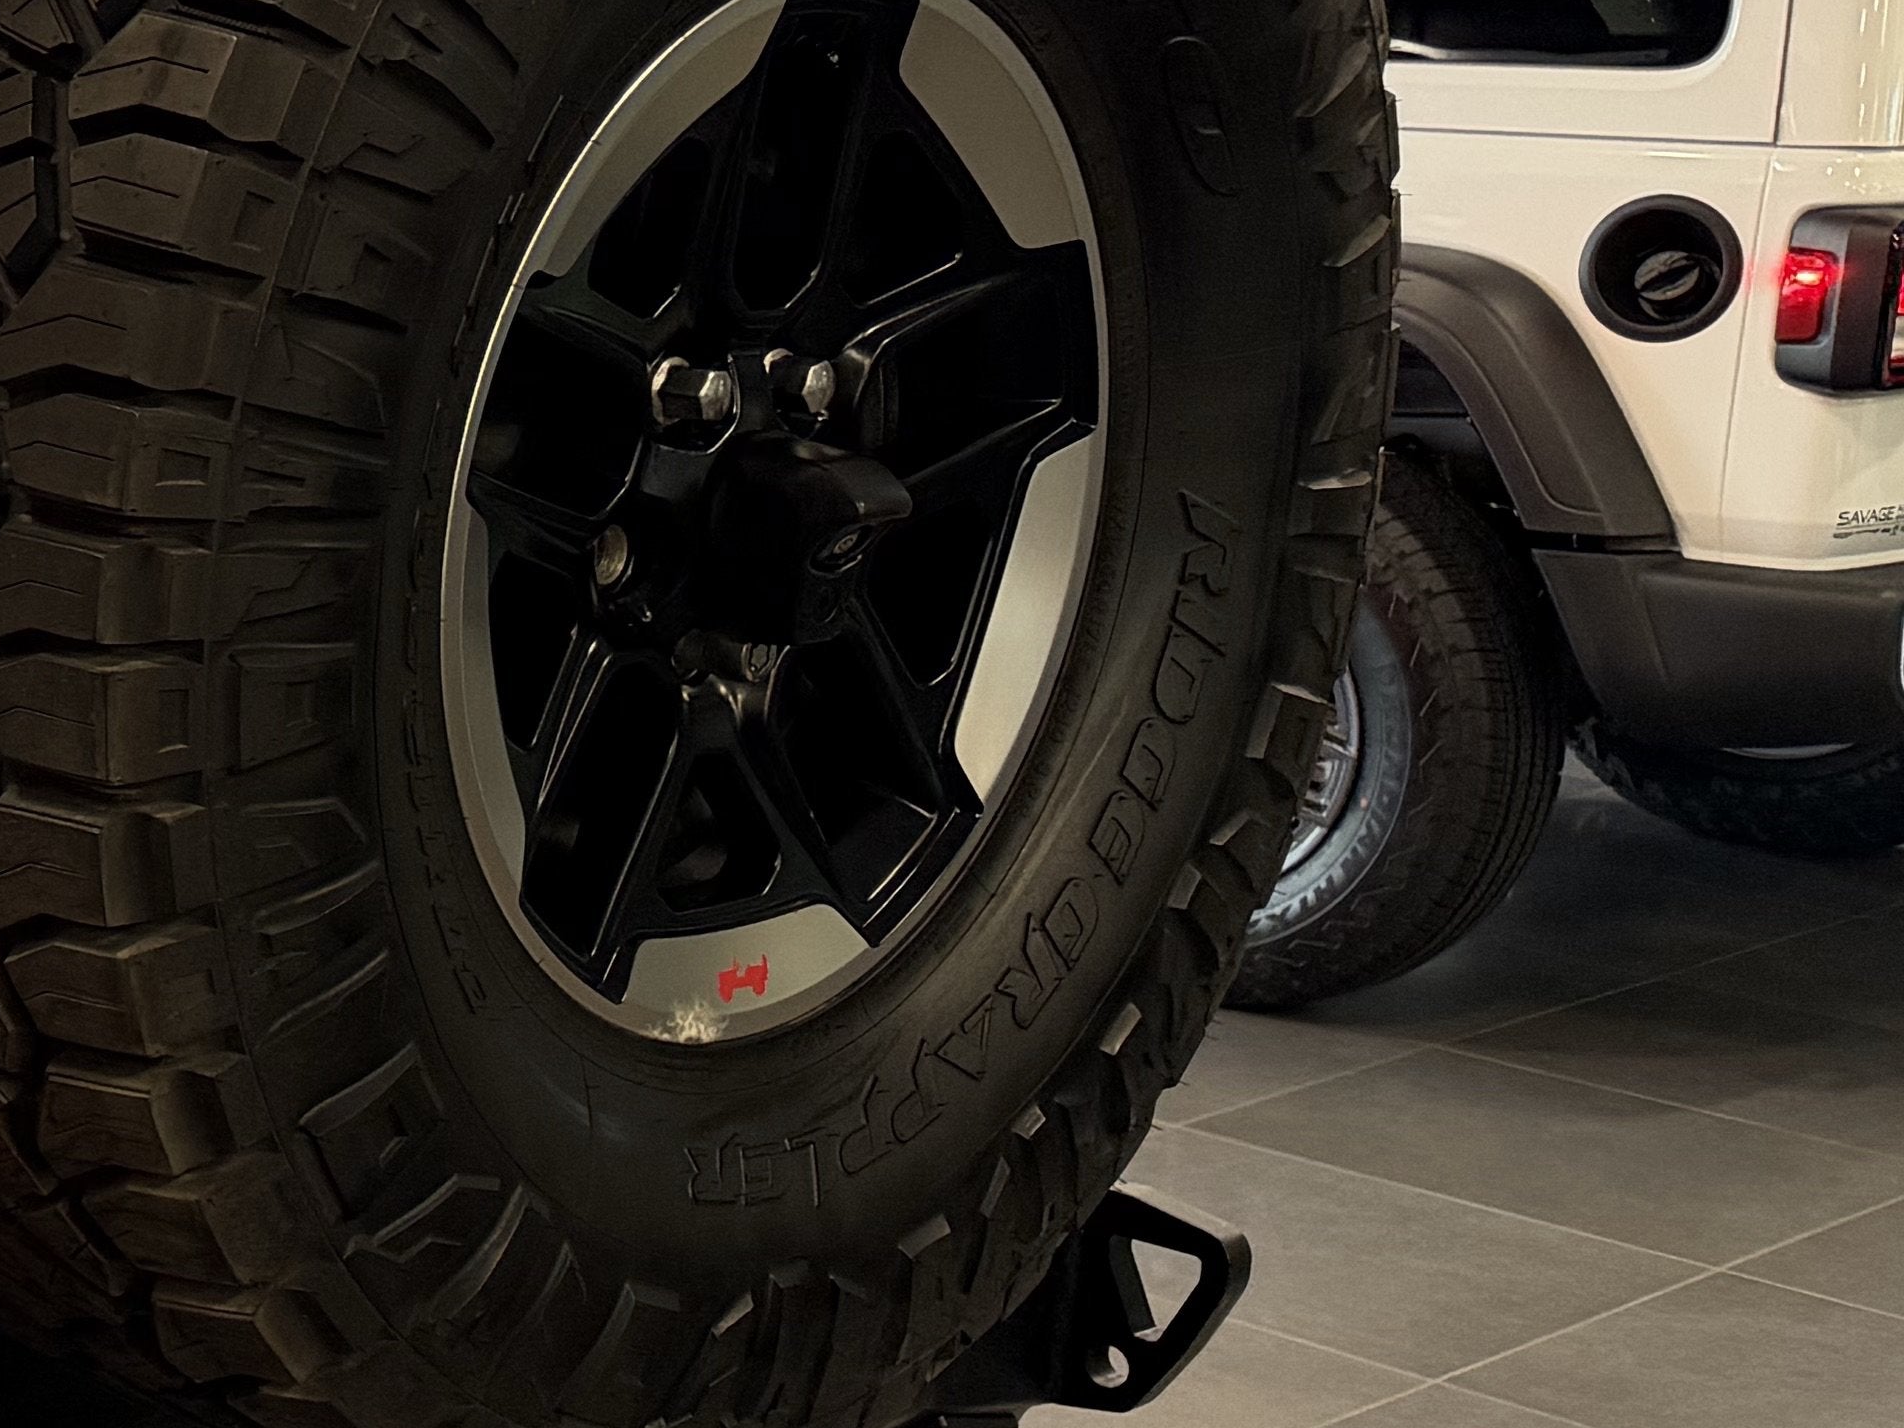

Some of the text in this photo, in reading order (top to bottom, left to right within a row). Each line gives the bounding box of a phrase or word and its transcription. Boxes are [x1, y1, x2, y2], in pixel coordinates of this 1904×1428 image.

[1836, 506, 1896, 526] SAVAGE
[1089, 486, 1242, 886] RIDGE
[683, 876, 1101, 1208] GRAPPLER
